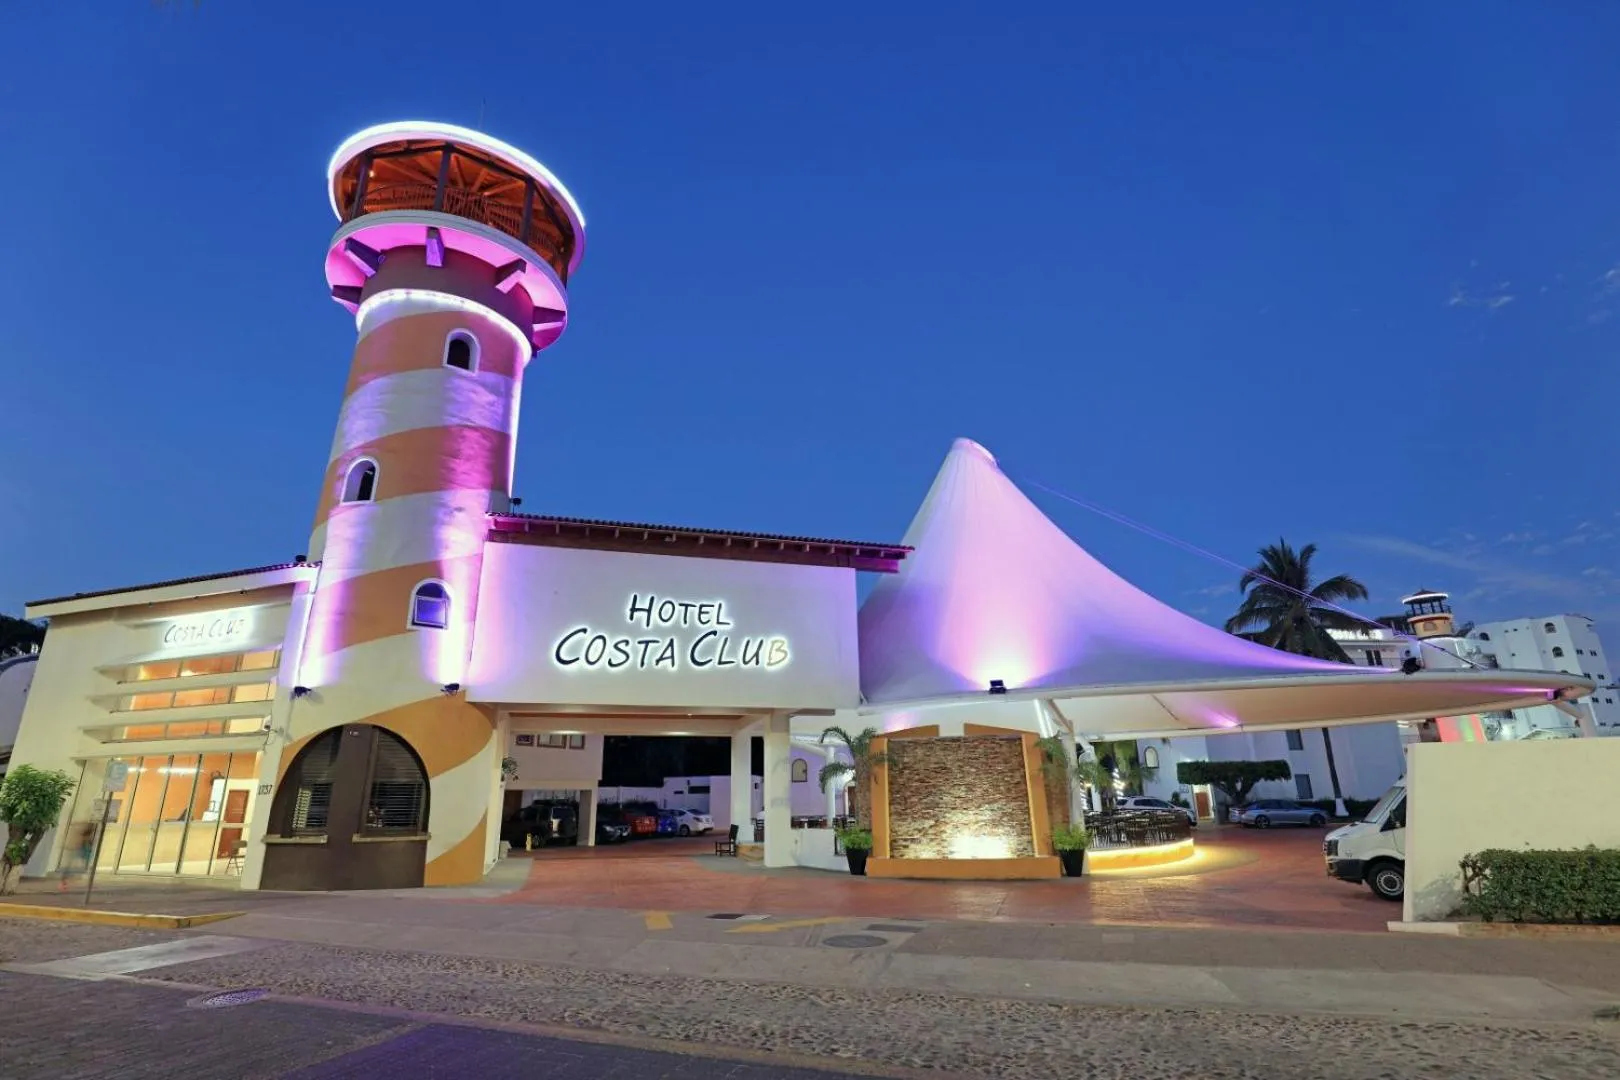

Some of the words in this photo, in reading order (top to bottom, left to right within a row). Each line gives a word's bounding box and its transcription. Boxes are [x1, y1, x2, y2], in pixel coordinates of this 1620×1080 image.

[629, 594, 731, 627] HOTEL
[554, 627, 676, 668] COSTA
[689, 630, 789, 667] CLUB
